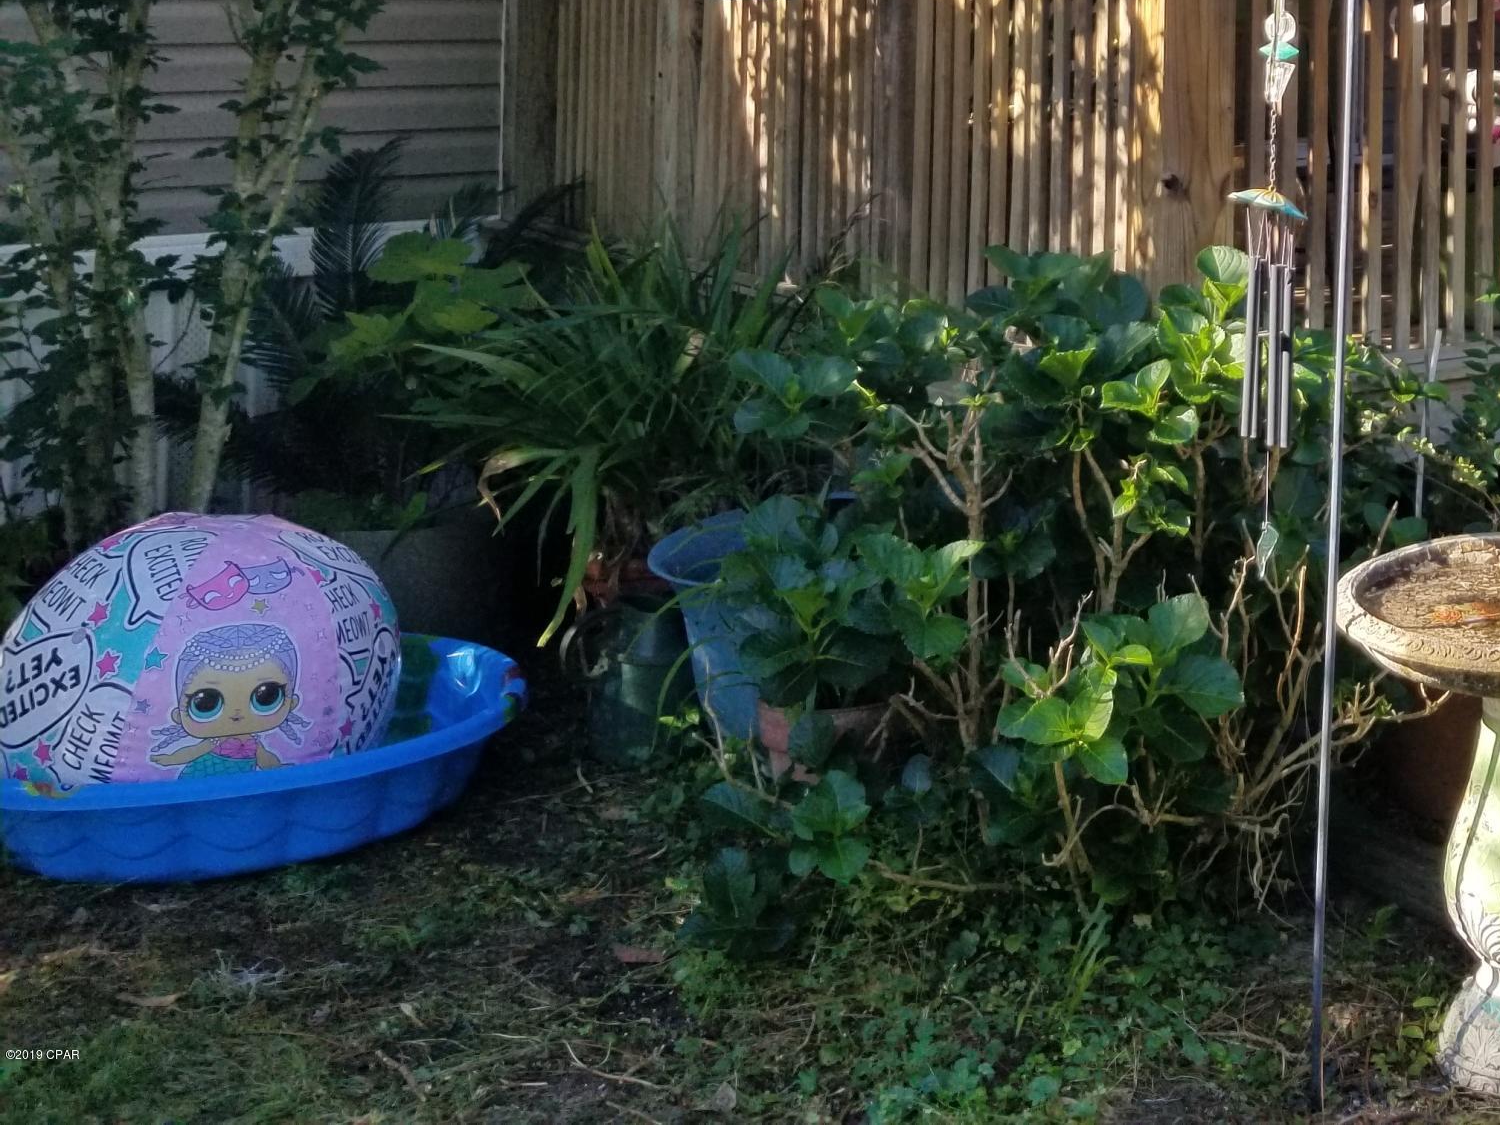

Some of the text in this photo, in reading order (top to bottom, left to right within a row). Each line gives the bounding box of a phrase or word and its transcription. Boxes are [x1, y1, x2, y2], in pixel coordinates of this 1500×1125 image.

[68, 555, 110, 590] HECK
[144, 544, 184, 602] EXCITED
[324, 582, 360, 614] HECK
[0, 665, 81, 729] EXCITED
[5, 647, 64, 695] YET?
[62, 702, 106, 771] CHECK
[88, 710, 126, 784] MEOWT
